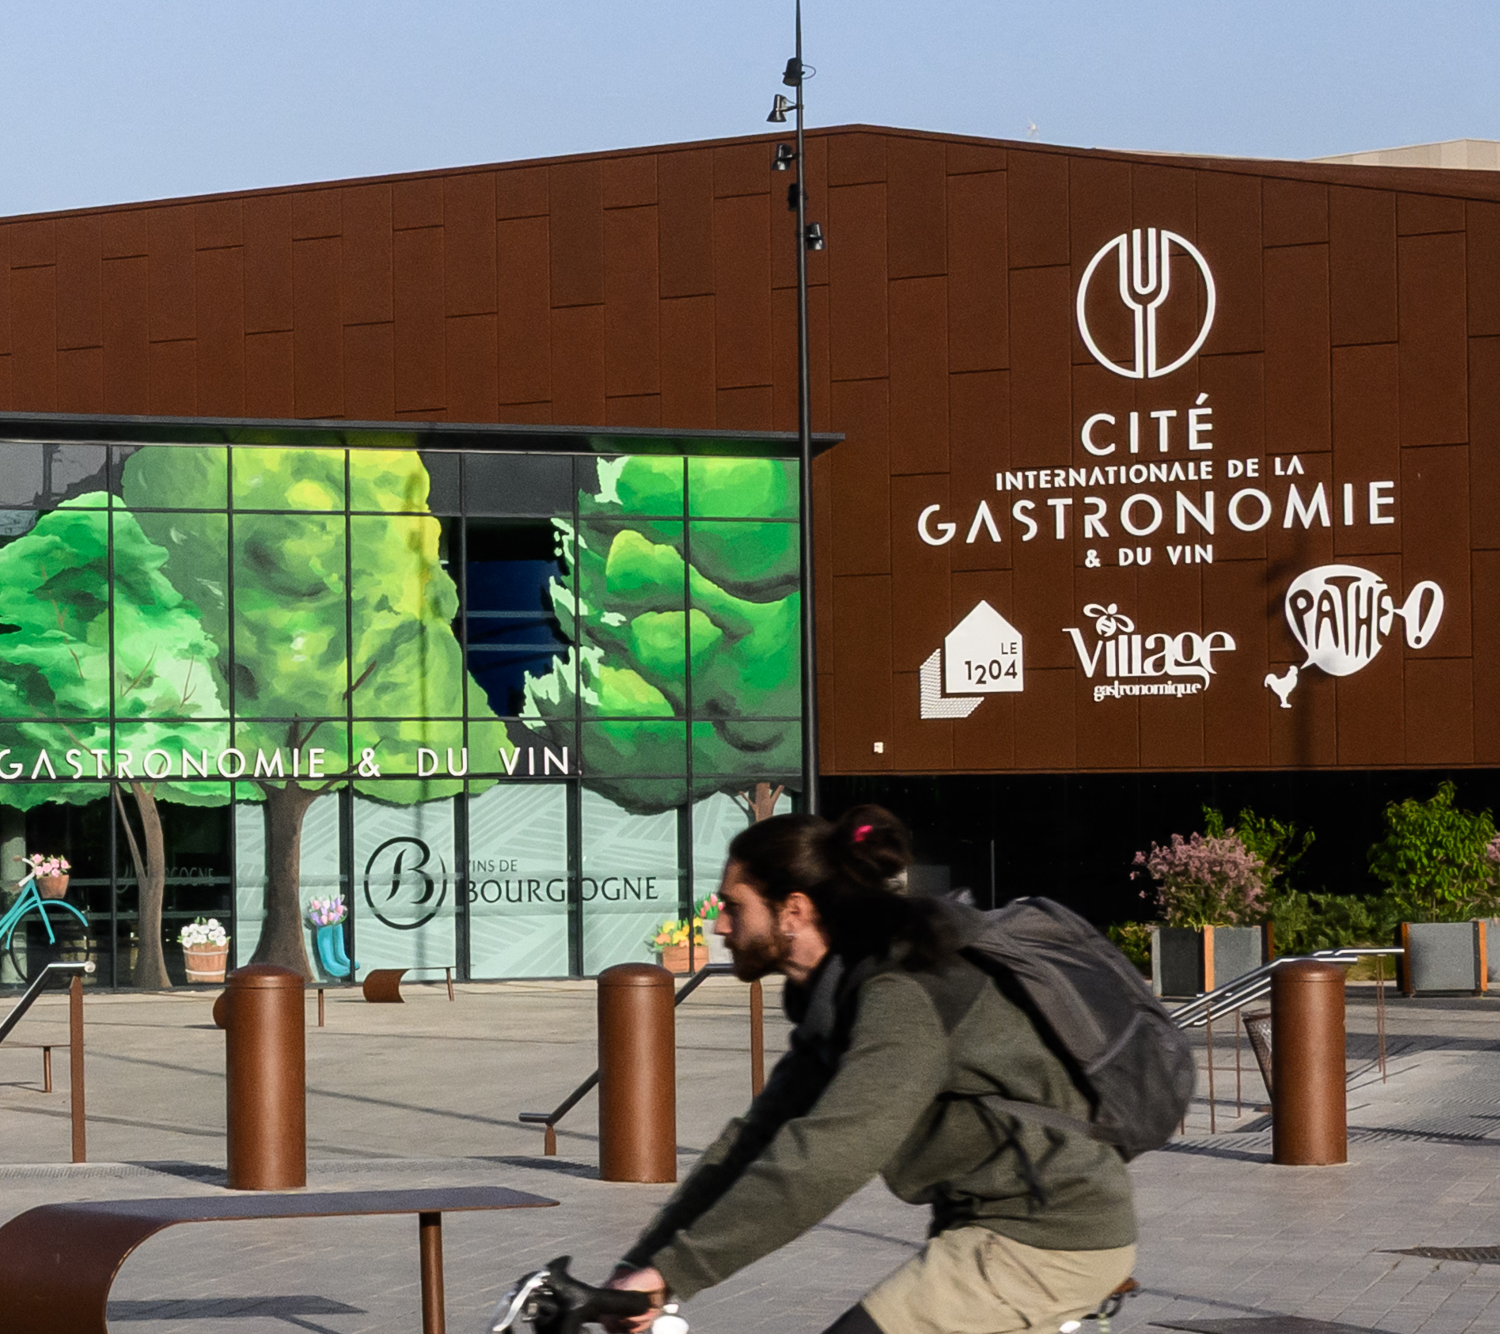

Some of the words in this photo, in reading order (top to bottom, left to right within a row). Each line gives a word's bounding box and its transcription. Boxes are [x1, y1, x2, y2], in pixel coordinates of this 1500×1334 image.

[1081, 393, 1213, 456] CITÉ
[996, 461, 1213, 491] INTERNATIONALE
[1228, 458, 1260, 479] DE
[1275, 455, 1304, 477] LA
[917, 481, 1395, 546] GASTRONOMIE
[1085, 549, 1101, 568] &
[1119, 547, 1152, 567] DU
[1167, 544, 1213, 565] VIN
[1001, 642, 1018, 655] LE
[1062, 628, 1236, 691] Village
[964, 659, 1018, 685] 1204
[1093, 680, 1202, 702] gastronomique
[357, 747, 381, 777] &
[417, 747, 468, 777] DU
[499, 746, 568, 776] VIN
[468, 860, 495, 872] INS
[499, 859, 518, 872] DE
